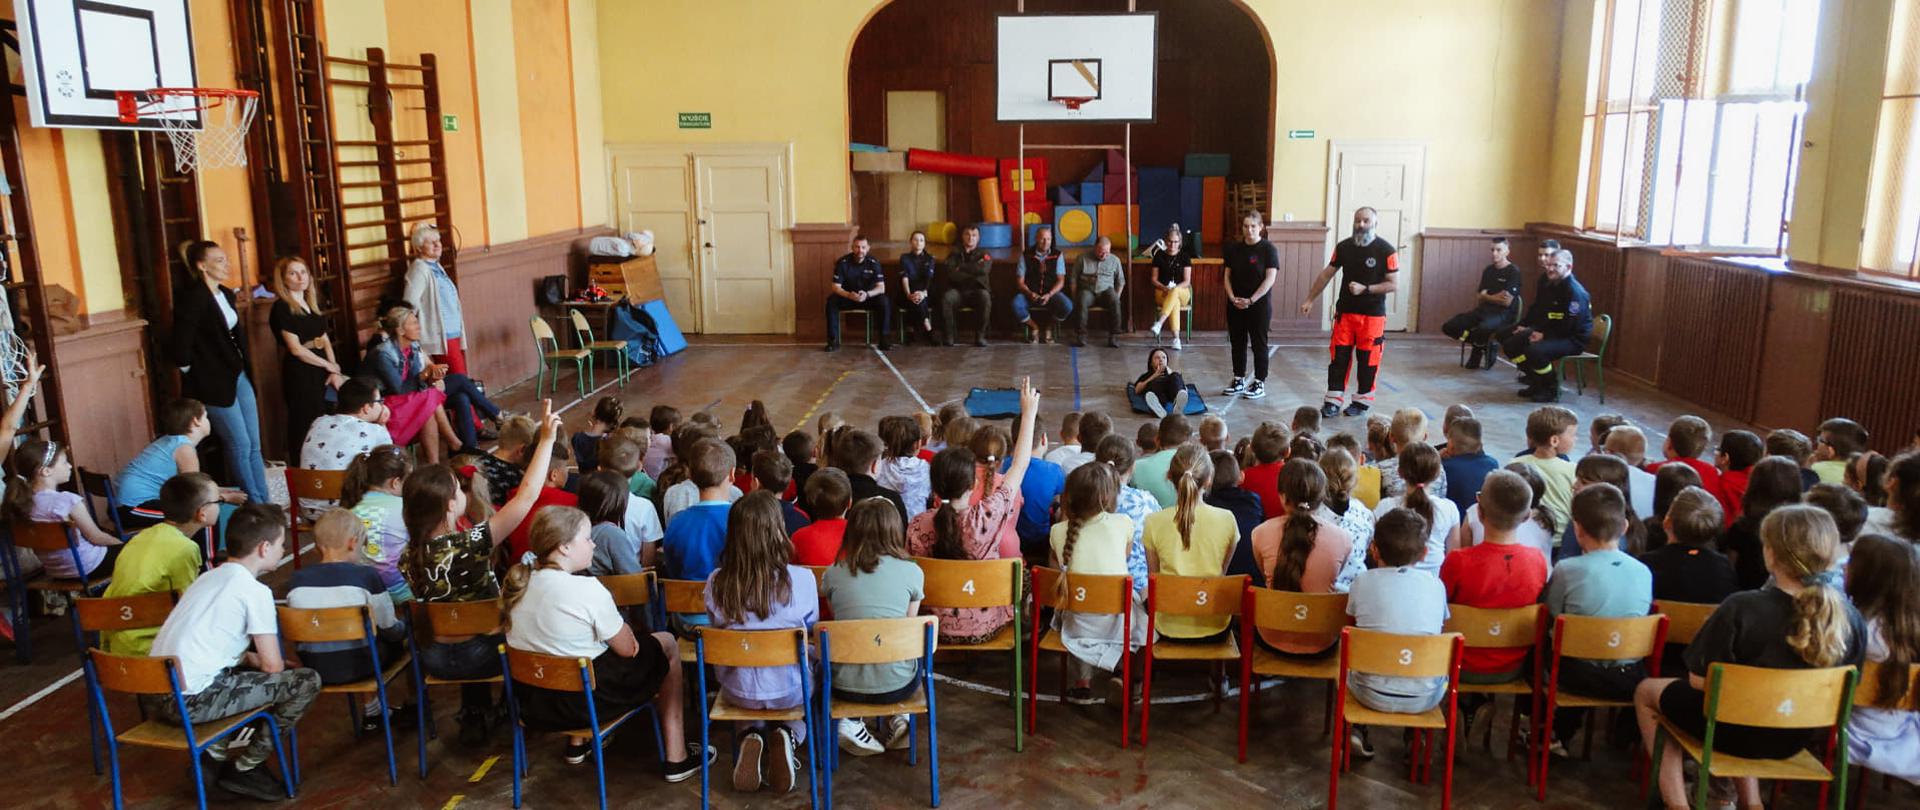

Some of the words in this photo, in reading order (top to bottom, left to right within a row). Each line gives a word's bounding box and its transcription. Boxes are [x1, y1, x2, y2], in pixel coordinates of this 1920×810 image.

[315, 479, 323, 489] 3
[962, 579, 976, 596] 4
[1075, 587, 1086, 602] 3
[1196, 591, 1208, 605] 3
[120, 605, 133, 620] 3
[1295, 605, 1308, 620] 3
[311, 615, 320, 627] 4
[1489, 622, 1501, 636] 3
[874, 634, 881, 646] 4
[1608, 632, 1621, 647] 3
[1399, 648, 1413, 665] 3
[534, 664, 544, 679] 3
[1776, 699, 1792, 716] 4
